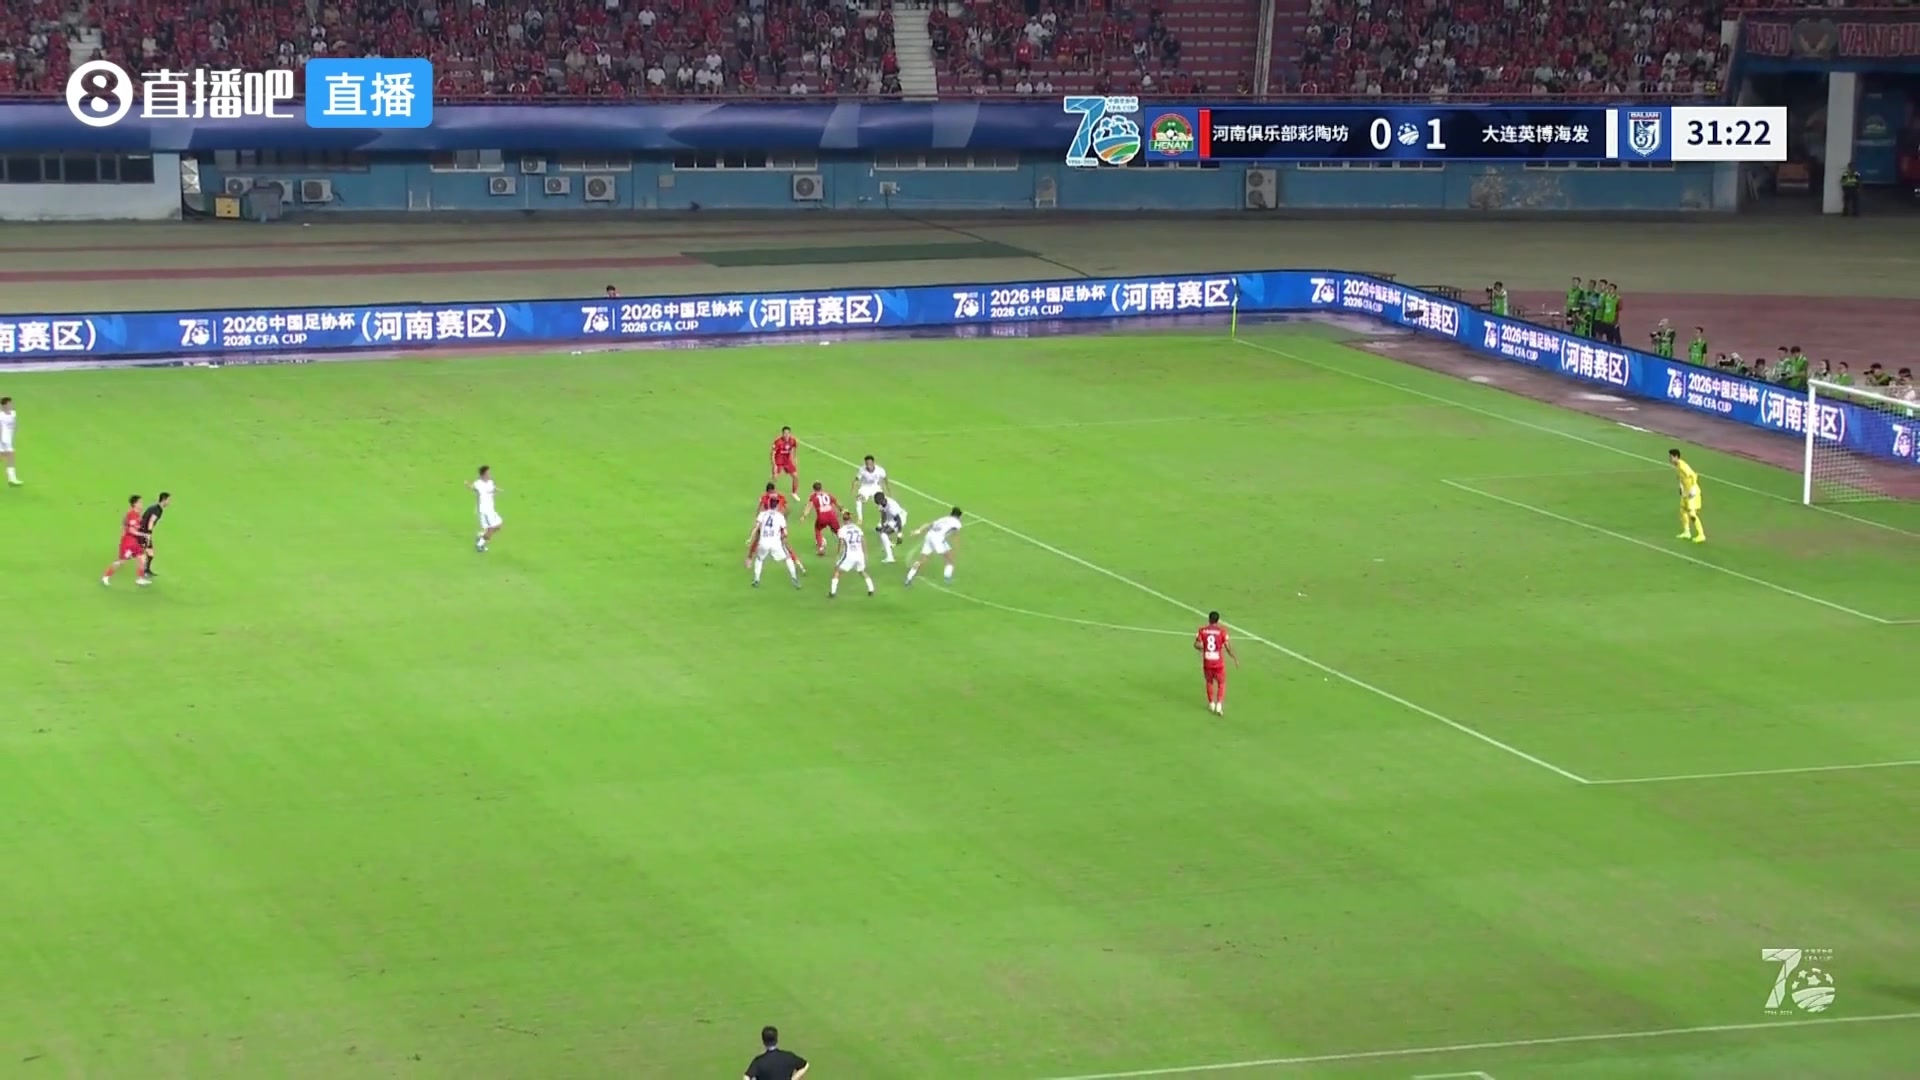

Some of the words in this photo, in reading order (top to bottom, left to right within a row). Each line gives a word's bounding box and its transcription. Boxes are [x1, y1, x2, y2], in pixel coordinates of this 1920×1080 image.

[991, 284, 1106, 305] 2026中国足协杯
[621, 299, 743, 321] 2026中国足协杯
[990, 306, 1015, 318] 2026
[1017, 306, 1039, 317] CFA
[1041, 305, 1064, 316] CUP
[223, 312, 355, 333] 2026中国足协杯
[621, 322, 647, 333] 2026
[650, 321, 672, 332] CFA
[675, 320, 699, 331] CUP
[223, 334, 252, 347] 2026
[254, 333, 279, 346] CFA
[282, 332, 307, 345] CUP
[1688, 372, 1760, 406] 2026中国足协杯
[1703, 396, 1717, 410] CFA
[1717, 400, 1733, 413] CUP
[818, 495, 831, 506] 10
[765, 516, 774, 527] 4
[848, 532, 862, 544] 22
[1207, 635, 1216, 651] 8
